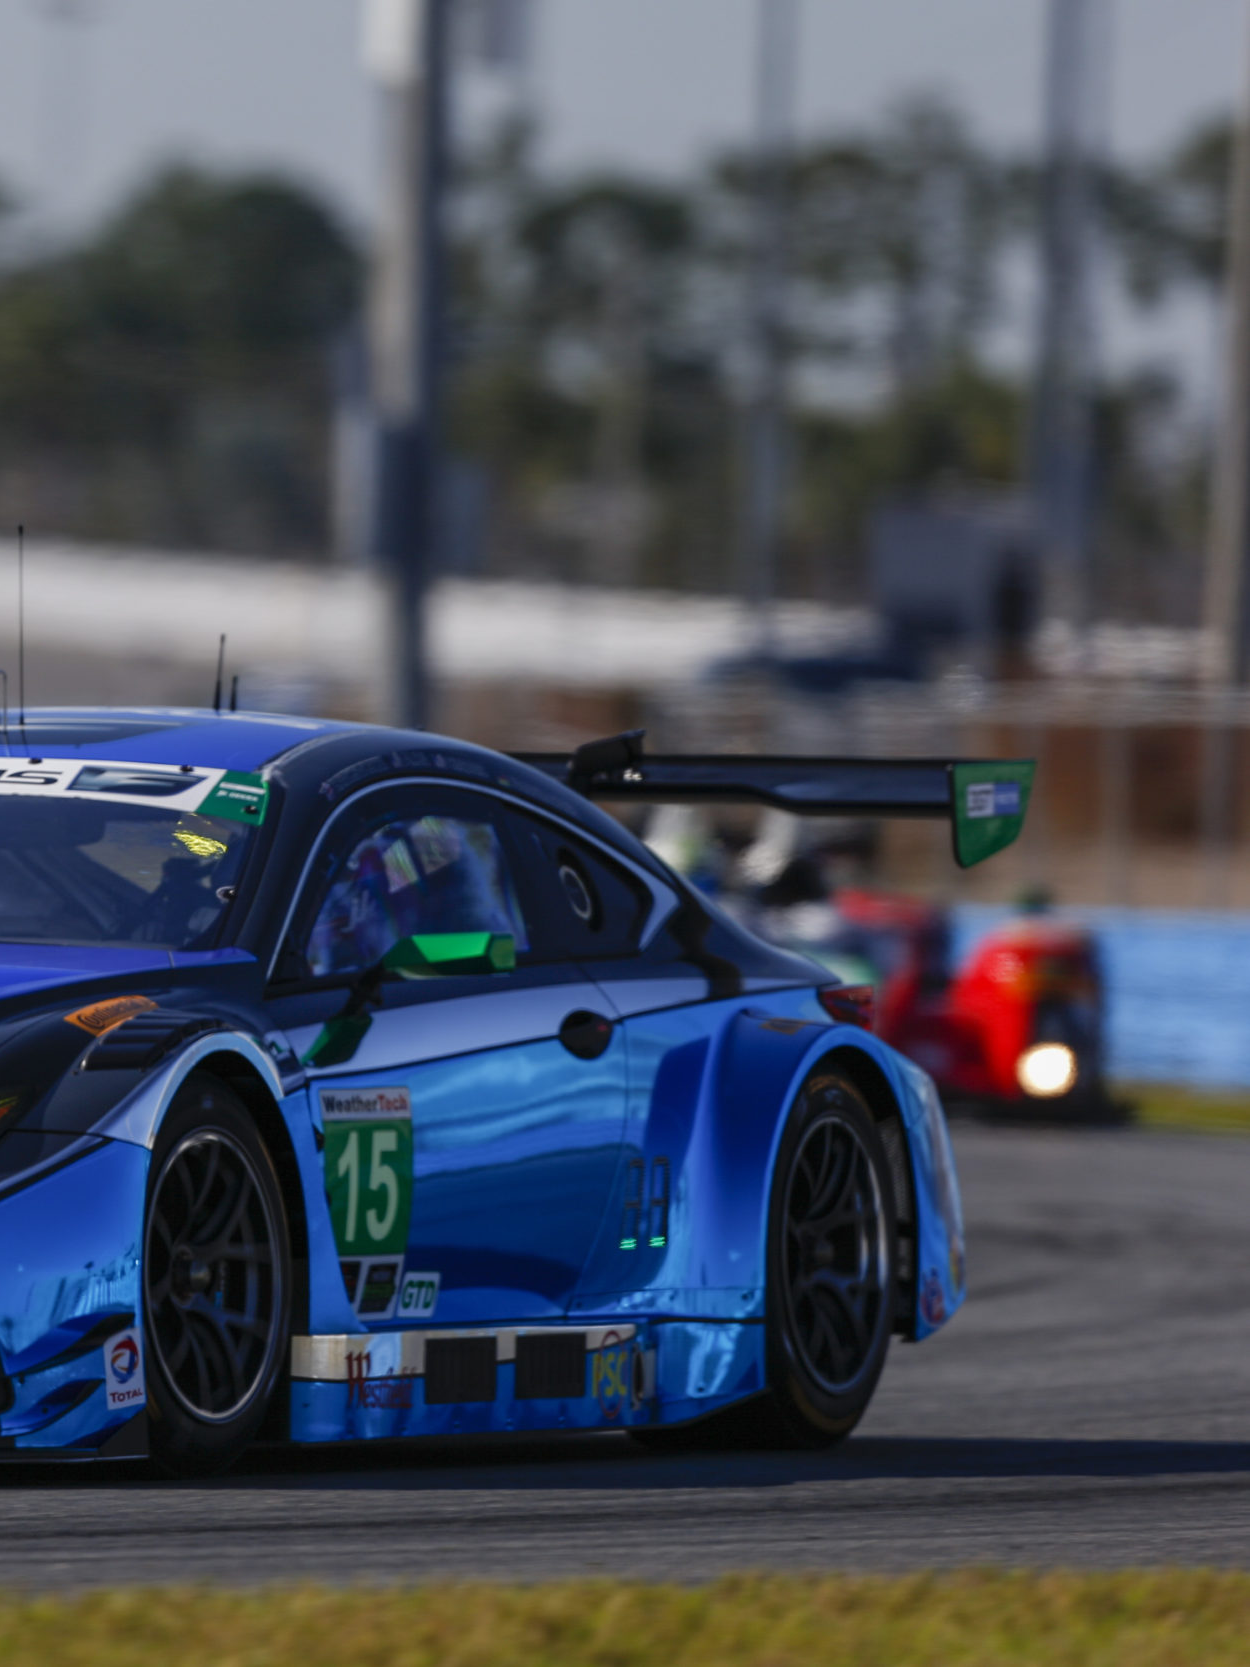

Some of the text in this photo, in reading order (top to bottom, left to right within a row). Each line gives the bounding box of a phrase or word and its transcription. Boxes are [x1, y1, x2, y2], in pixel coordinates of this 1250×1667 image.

[321, 1094, 408, 1114] WeatherTech
[337, 1130, 399, 1242] 15
[401, 1280, 436, 1310] GTD
[109, 1388, 143, 1403] TOTAL
